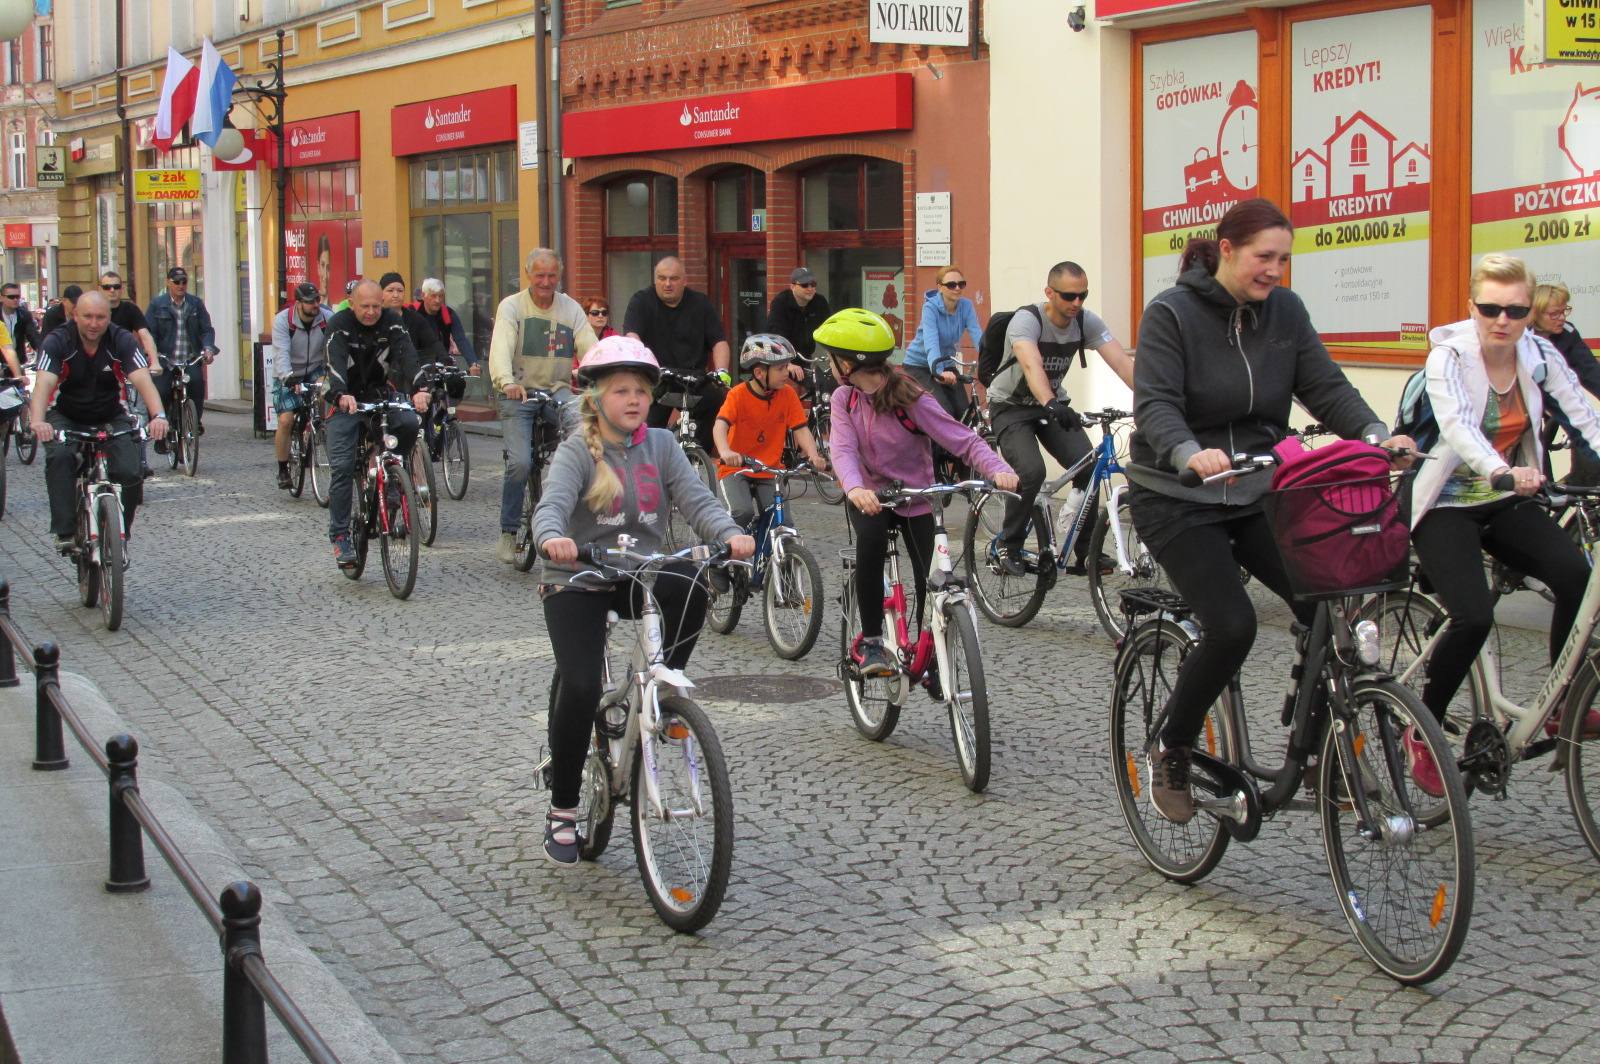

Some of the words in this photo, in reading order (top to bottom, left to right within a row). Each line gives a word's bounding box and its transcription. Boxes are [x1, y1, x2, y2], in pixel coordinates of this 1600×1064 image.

[876, 3, 964, 33] NOTARIUSZ
[1566, 16, 1577, 28] w
[1581, 13, 1596, 28] 15
[1303, 40, 1352, 68] Lepszy
[1149, 68, 1186, 92] Szybka
[1313, 60, 1382, 93] KREDYT!
[1156, 81, 1222, 111] GOTÓWKA!
[435, 103, 472, 127] Santander
[693, 101, 740, 124] Santander
[694, 129, 719, 139] CONSUMER
[719, 127, 732, 137] BANK
[162, 171, 186, 183] żak
[154, 189, 200, 200] DARMO!
[1328, 192, 1393, 218] KREDYTY
[1514, 182, 1600, 213] POŻYCZKI
[1162, 199, 1238, 228] CHWILÓWK
[1315, 228, 1333, 247] do
[1336, 221, 1389, 245] 200.000
[1393, 217, 1406, 238] zł
[1524, 217, 1570, 243] 2.000
[1574, 213, 1591, 237] zł
[285, 229, 305, 252] Wejdź
[1169, 232, 1184, 250] do
[757, 430, 765, 444] 6
